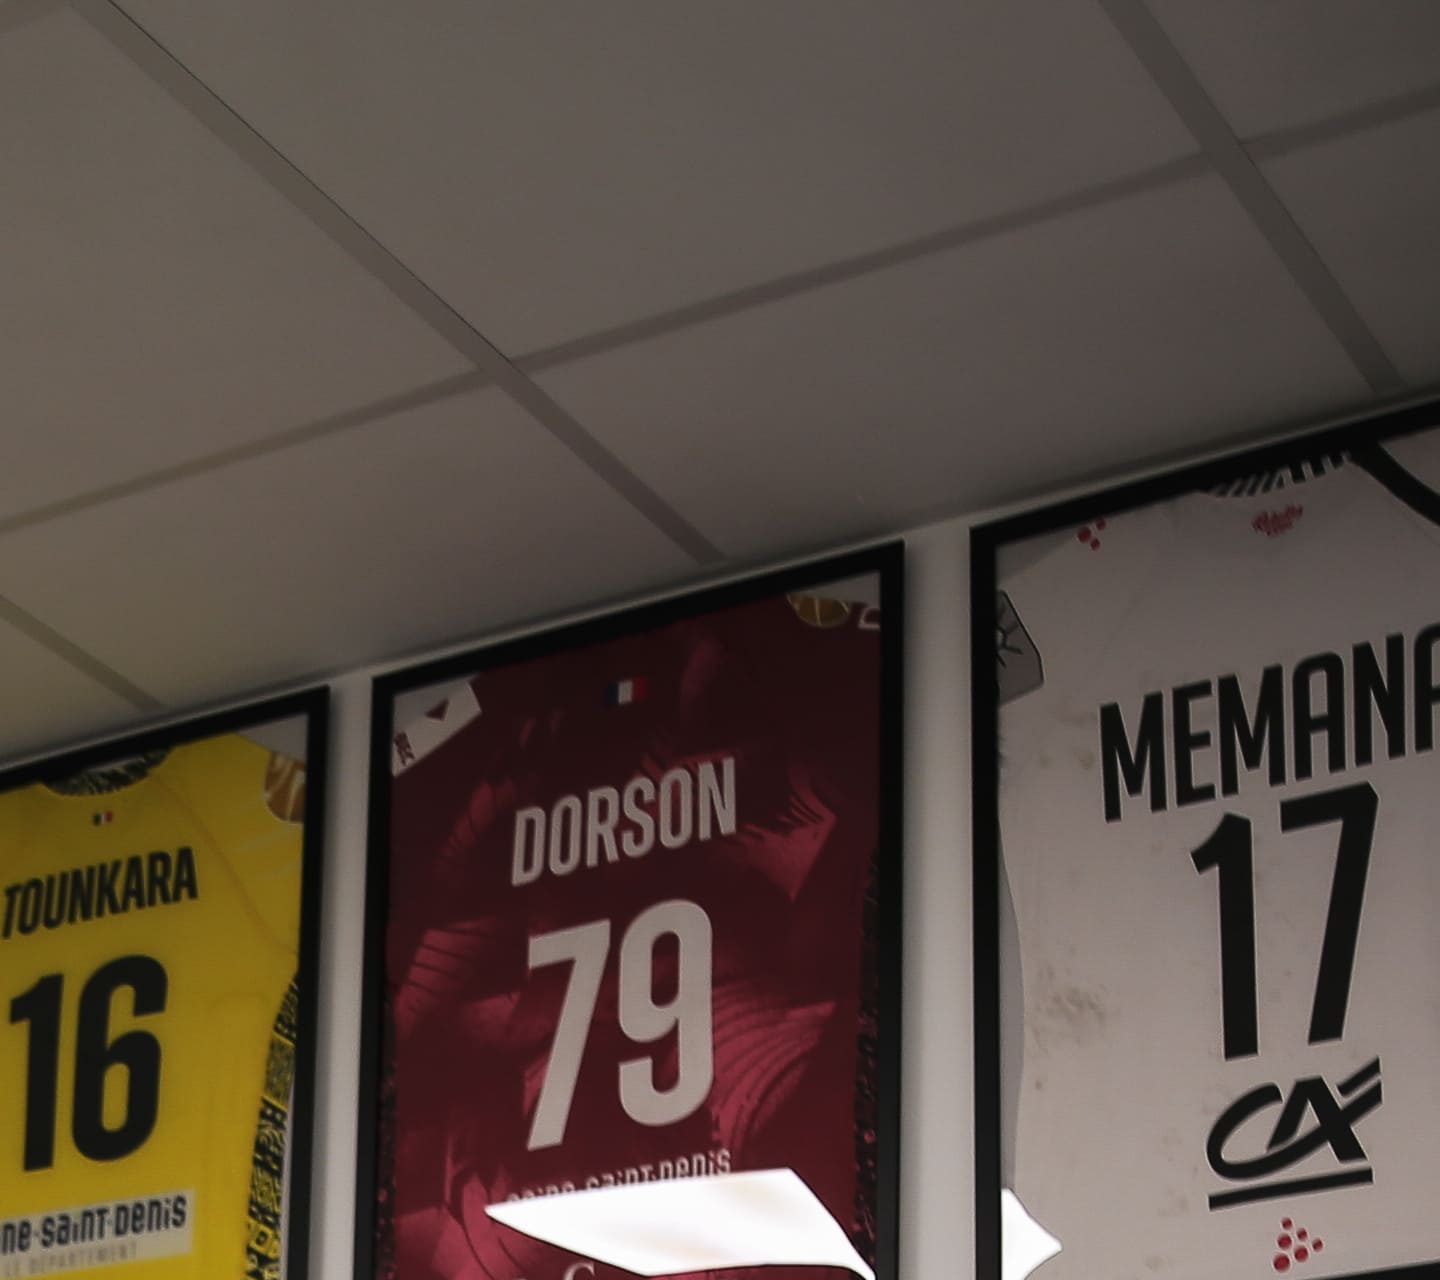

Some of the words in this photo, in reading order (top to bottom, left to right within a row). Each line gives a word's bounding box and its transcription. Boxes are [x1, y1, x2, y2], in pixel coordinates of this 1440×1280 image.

[0, 846, 199, 940] TOUNKARA
[511, 756, 738, 888] DORSON
[1189, 780, 1380, 1062] 17
[9, 954, 169, 1173] 16
[525, 898, 716, 1152] 79
